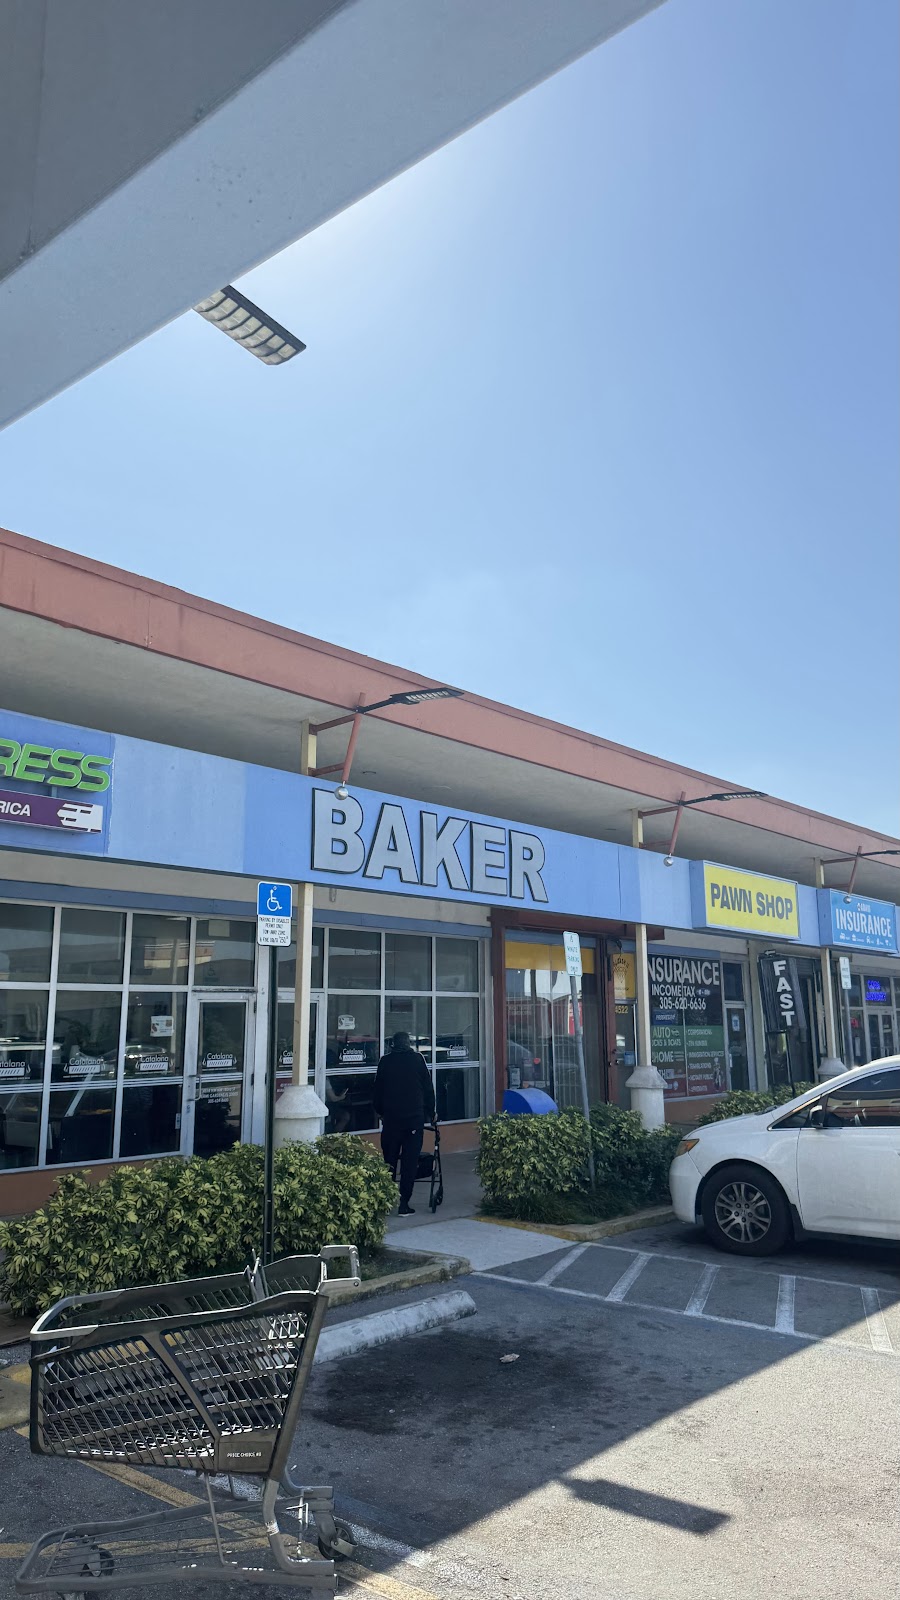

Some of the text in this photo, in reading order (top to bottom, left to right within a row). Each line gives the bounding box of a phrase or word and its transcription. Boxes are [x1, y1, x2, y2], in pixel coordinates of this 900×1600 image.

[0, 738, 113, 792] RESS
[0, 801, 31, 817] RICA
[311, 787, 549, 903] BAKER
[710, 882, 793, 920] PAWN SHOP
[835, 908, 893, 938] INSURANCE
[648, 957, 719, 985] NSURANCE
[652, 984, 681, 996] INCOME
[682, 986, 696, 997] TAX
[660, 997, 706, 1010] 305-620-6636
[773, 960, 795, 1026] FAST
[652, 1026, 670, 1038] AUTO
[206, 1052, 233, 1060] Catalana
